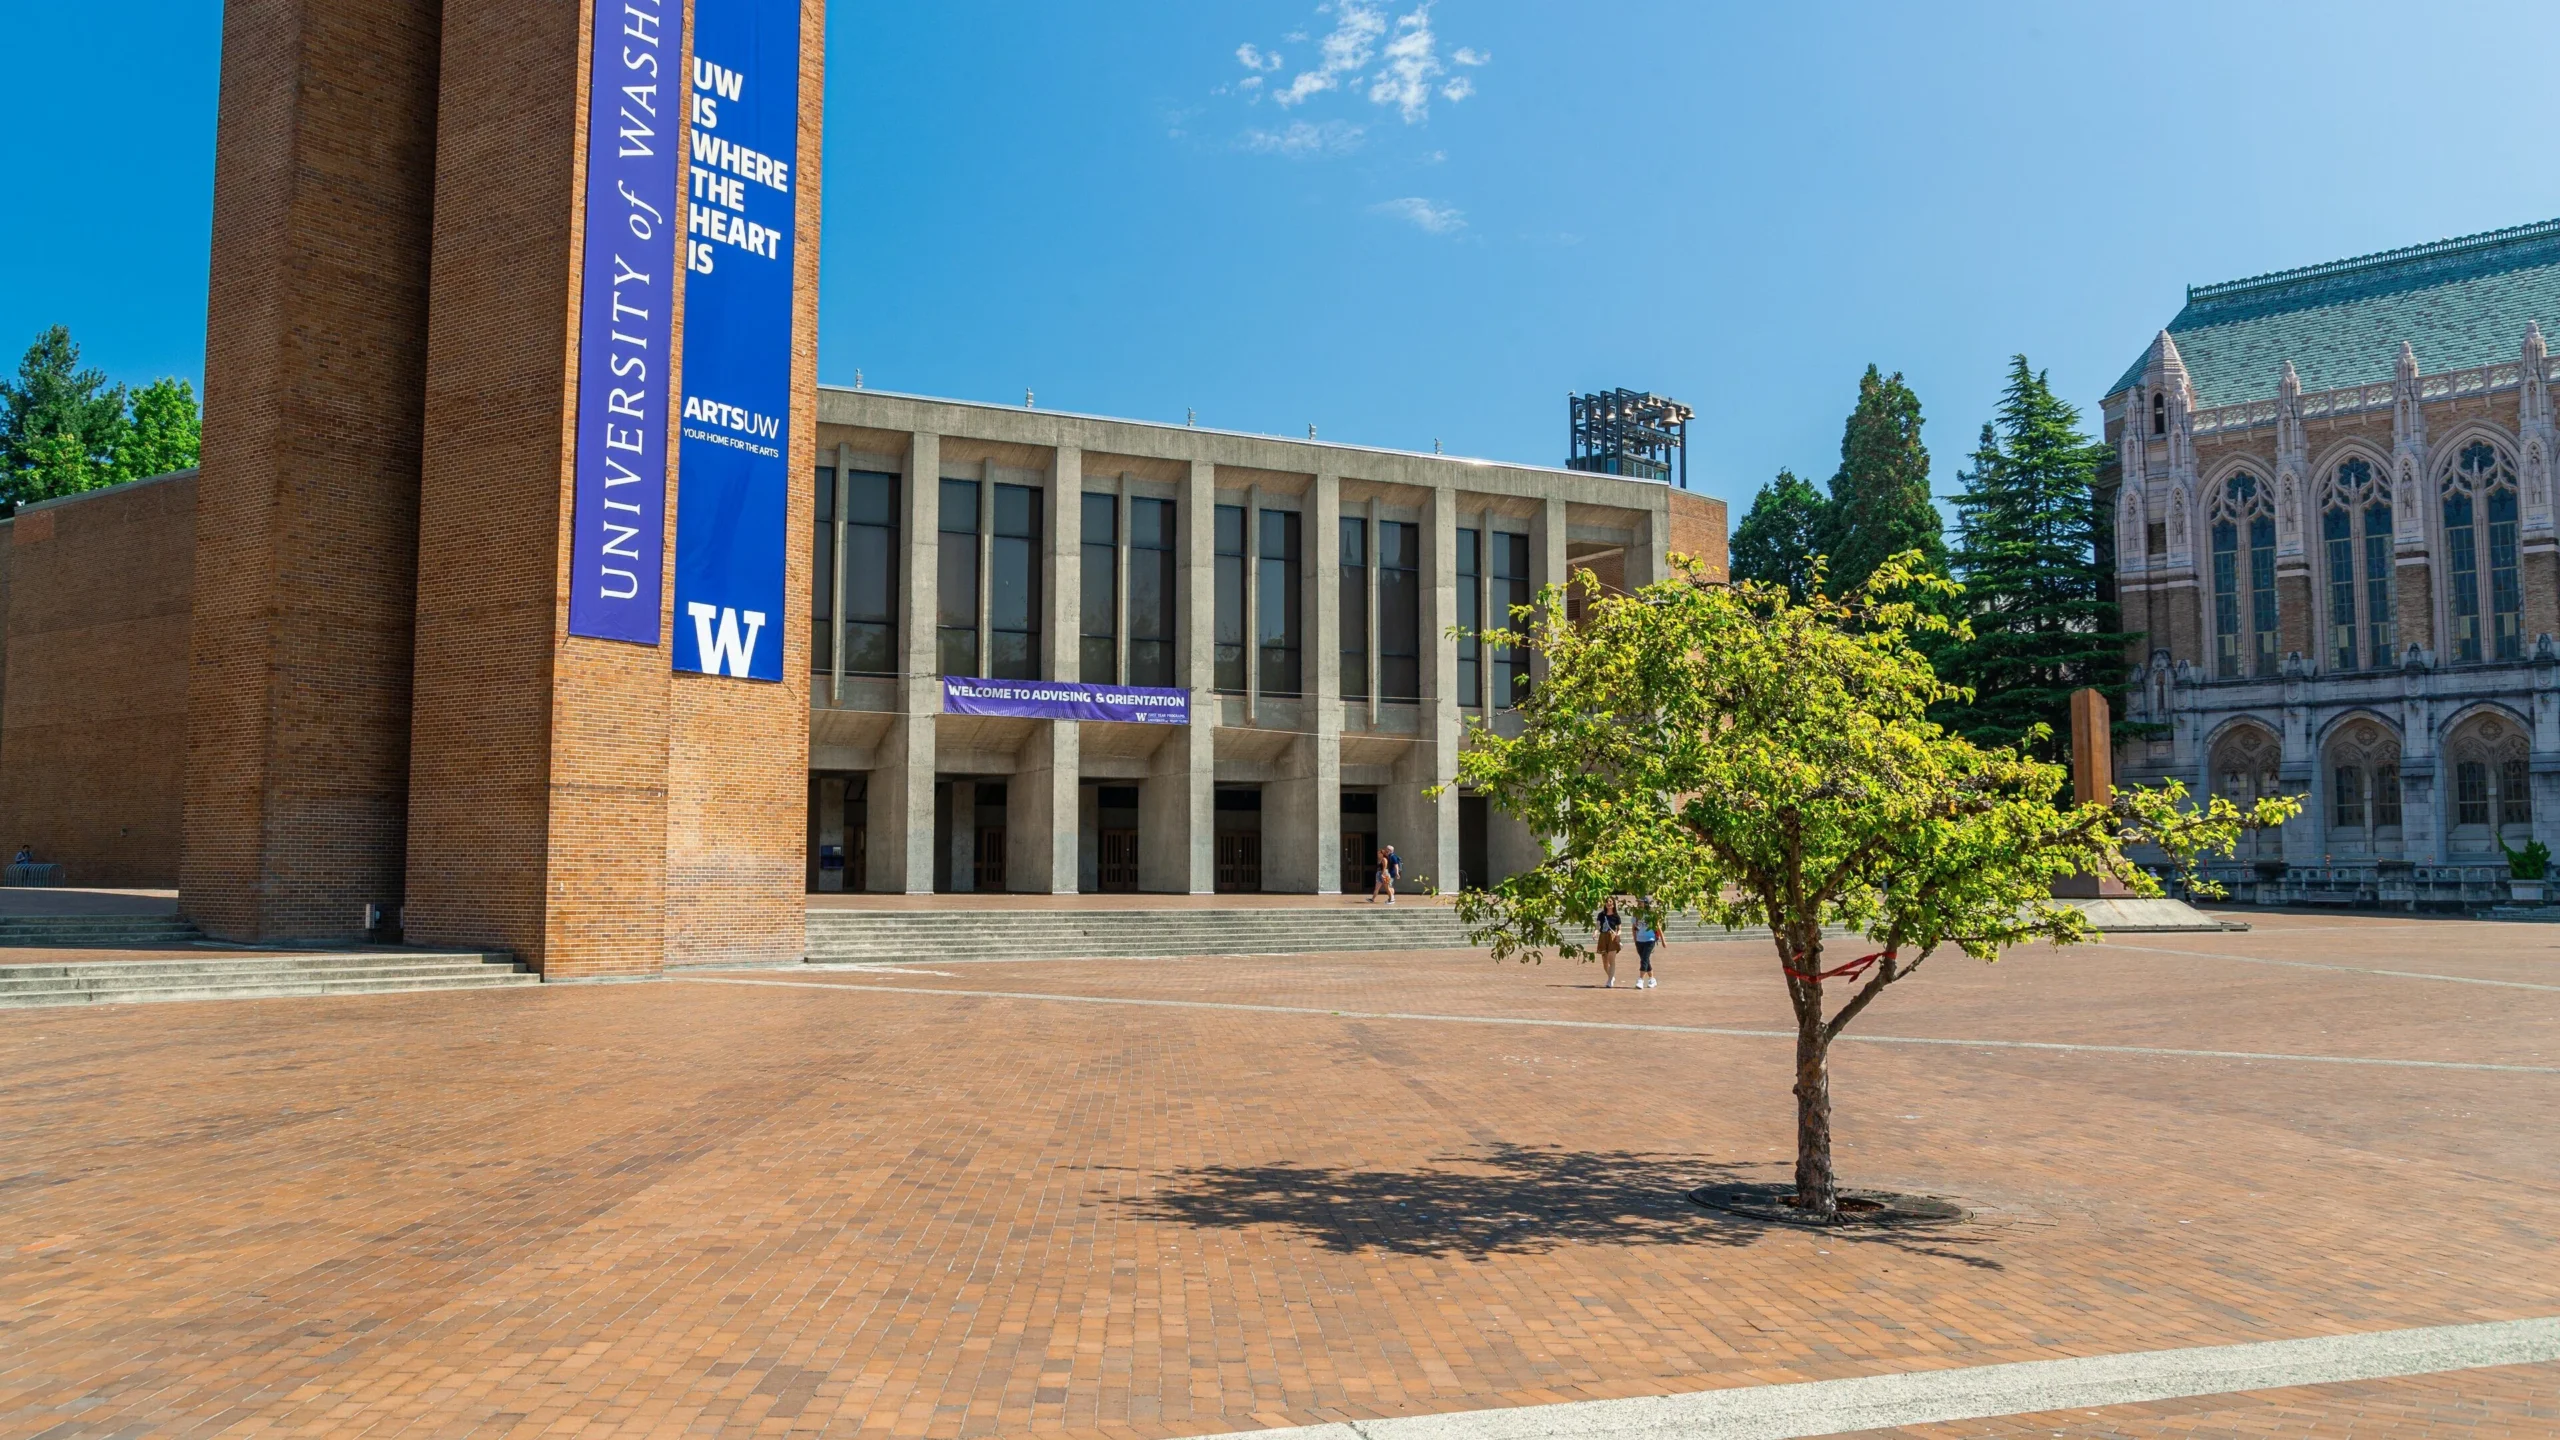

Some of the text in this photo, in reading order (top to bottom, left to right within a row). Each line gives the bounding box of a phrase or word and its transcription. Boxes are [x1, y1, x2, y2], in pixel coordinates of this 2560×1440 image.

[693, 56, 743, 101] UW
[692, 93, 718, 128] IS
[691, 129, 788, 193] WHERE
[690, 166, 744, 212] THE
[689, 204, 781, 260] HEART
[688, 239, 713, 275] IS
[601, 0, 662, 599] UNIVERSITY of WASH
[683, 396, 779, 440] ARTSUW
[683, 427, 779, 459] YOUR HOME FOR THE ARTS
[688, 601, 765, 678] W
[948, 684, 1185, 707] WELCOME TO ADVISING & ORIENTATION
[1135, 712, 1147, 722] W
